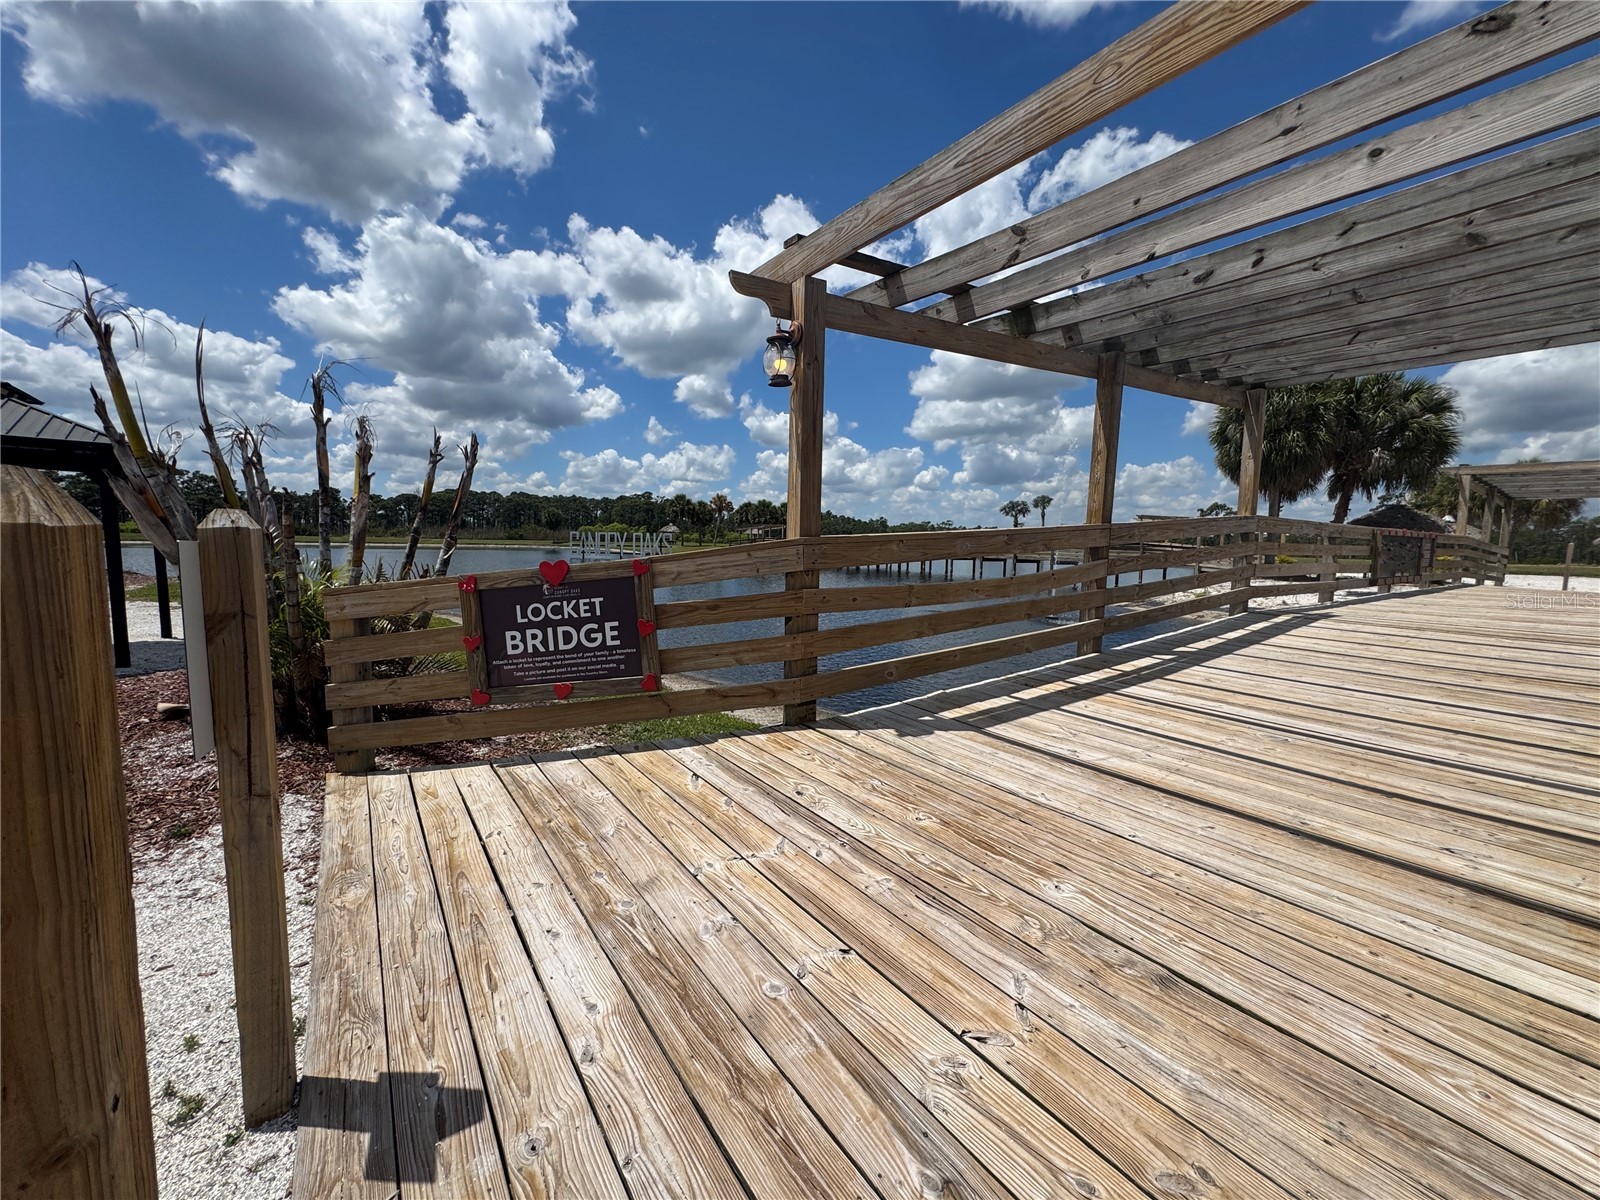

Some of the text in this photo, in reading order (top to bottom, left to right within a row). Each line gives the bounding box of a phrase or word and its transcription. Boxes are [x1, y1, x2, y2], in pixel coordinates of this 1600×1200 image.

[569, 531, 672, 557] CANOPY OAKS
[515, 597, 604, 623] LOCKET
[505, 621, 621, 655] BRIDGE
